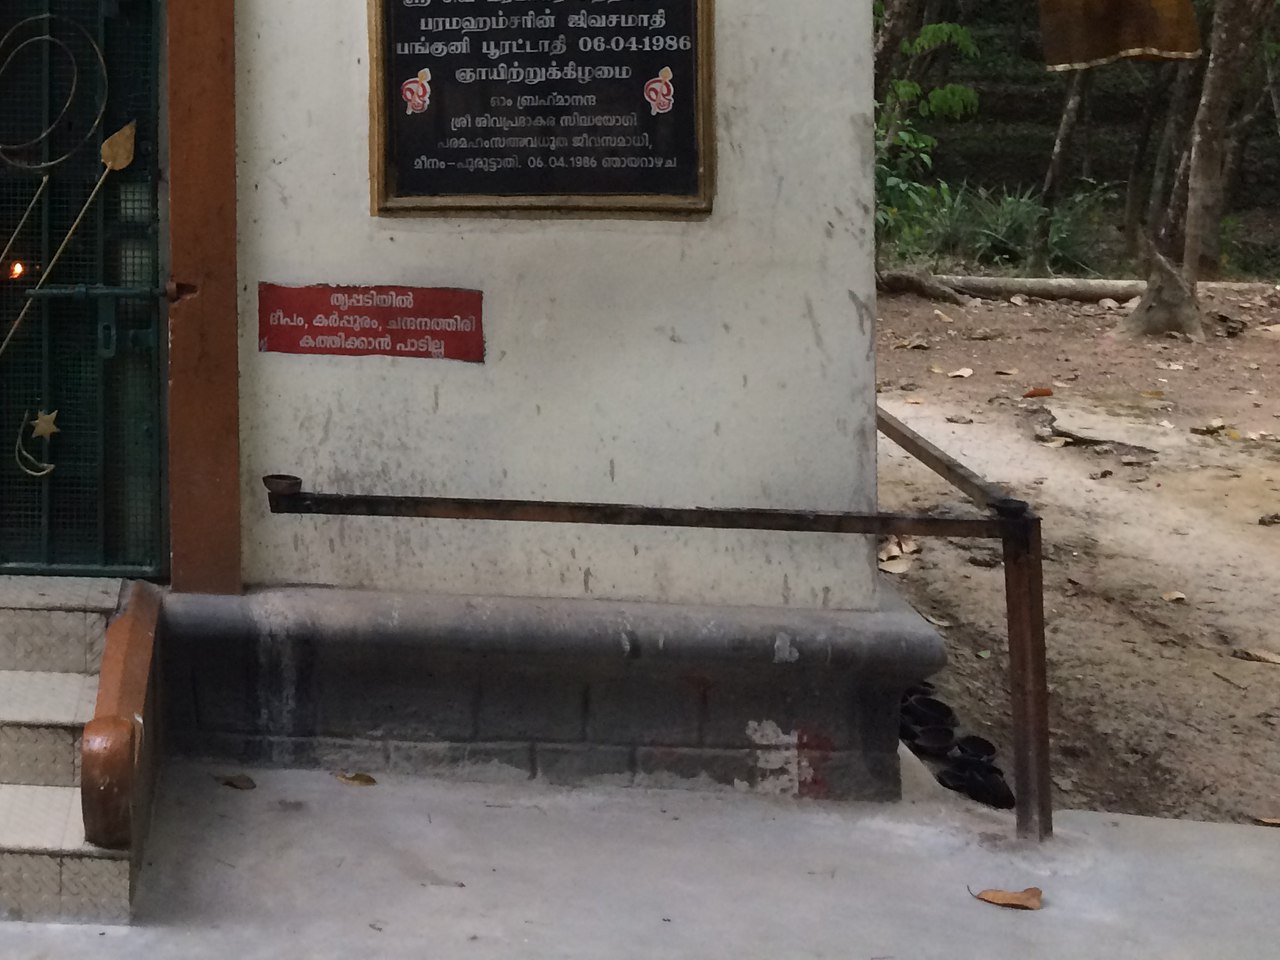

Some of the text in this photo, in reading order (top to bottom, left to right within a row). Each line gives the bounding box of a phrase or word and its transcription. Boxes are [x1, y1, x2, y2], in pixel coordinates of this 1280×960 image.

[396, 34, 691, 59] பங்குனி பூரட்டாதி 06-04-1986
[455, 61, 632, 85] ஞாயிற்றுக்கிழமை
[527, 156, 597, 168] 06.04.1986
